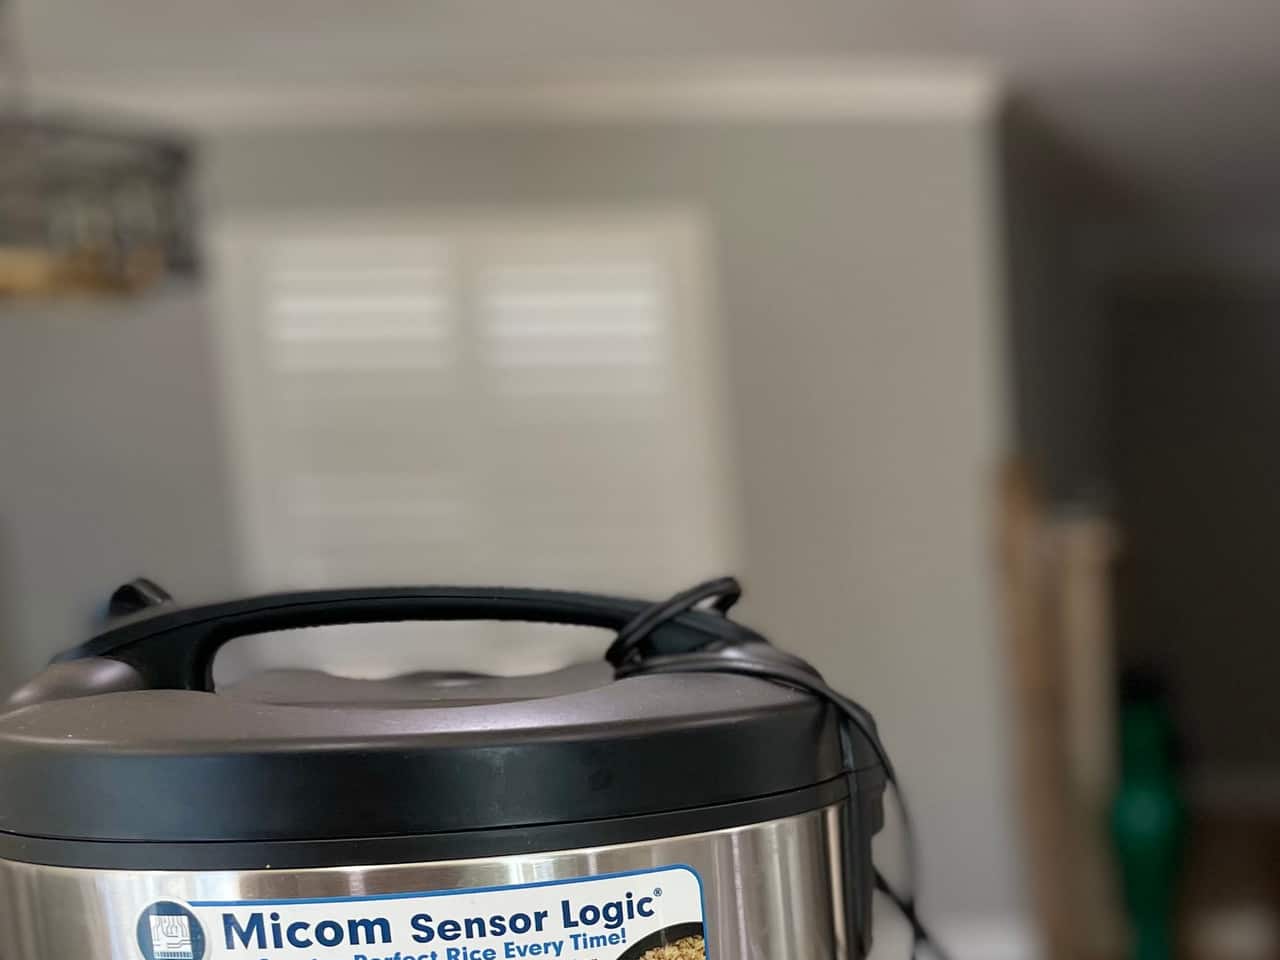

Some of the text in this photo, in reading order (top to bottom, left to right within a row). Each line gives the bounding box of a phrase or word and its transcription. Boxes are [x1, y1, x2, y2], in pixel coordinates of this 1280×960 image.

[222, 912, 393, 950] Micom
[410, 909, 548, 944] Sensor
[504, 940, 564, 959] Every
[569, 928, 627, 951] Time!
